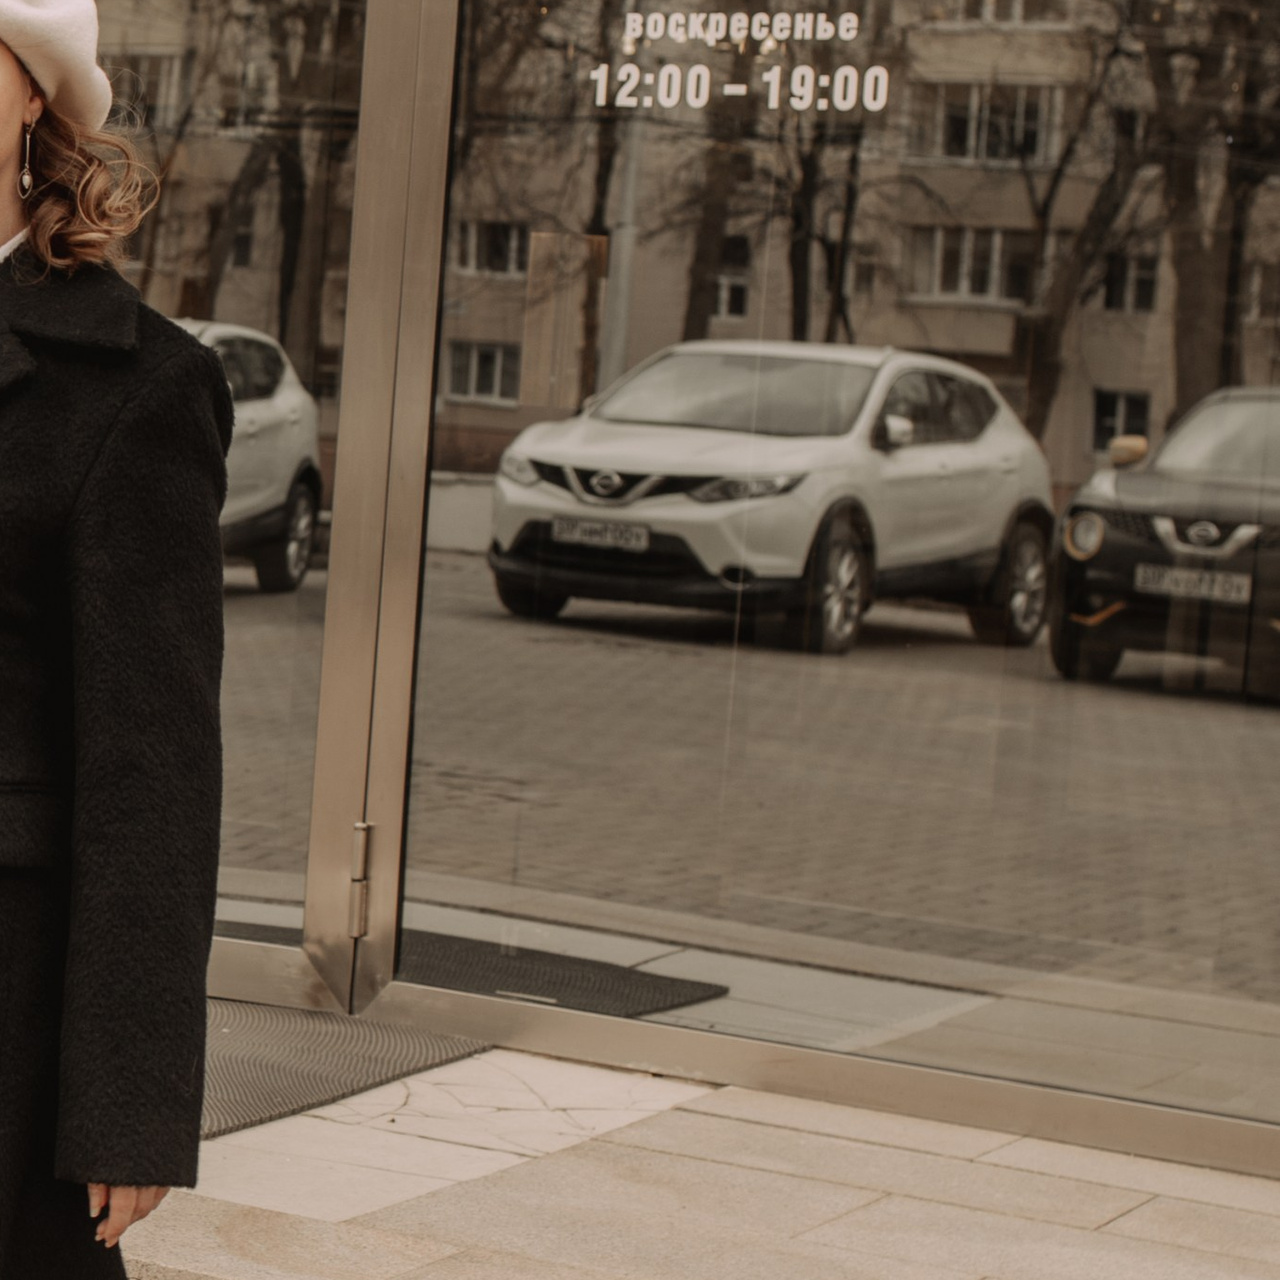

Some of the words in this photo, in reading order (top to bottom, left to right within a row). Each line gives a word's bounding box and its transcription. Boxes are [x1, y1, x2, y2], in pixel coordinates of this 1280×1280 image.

[623, 11, 860, 47] воскресенье
[590, 63, 712, 109] 12:00
[761, 64, 890, 112] 19:00
